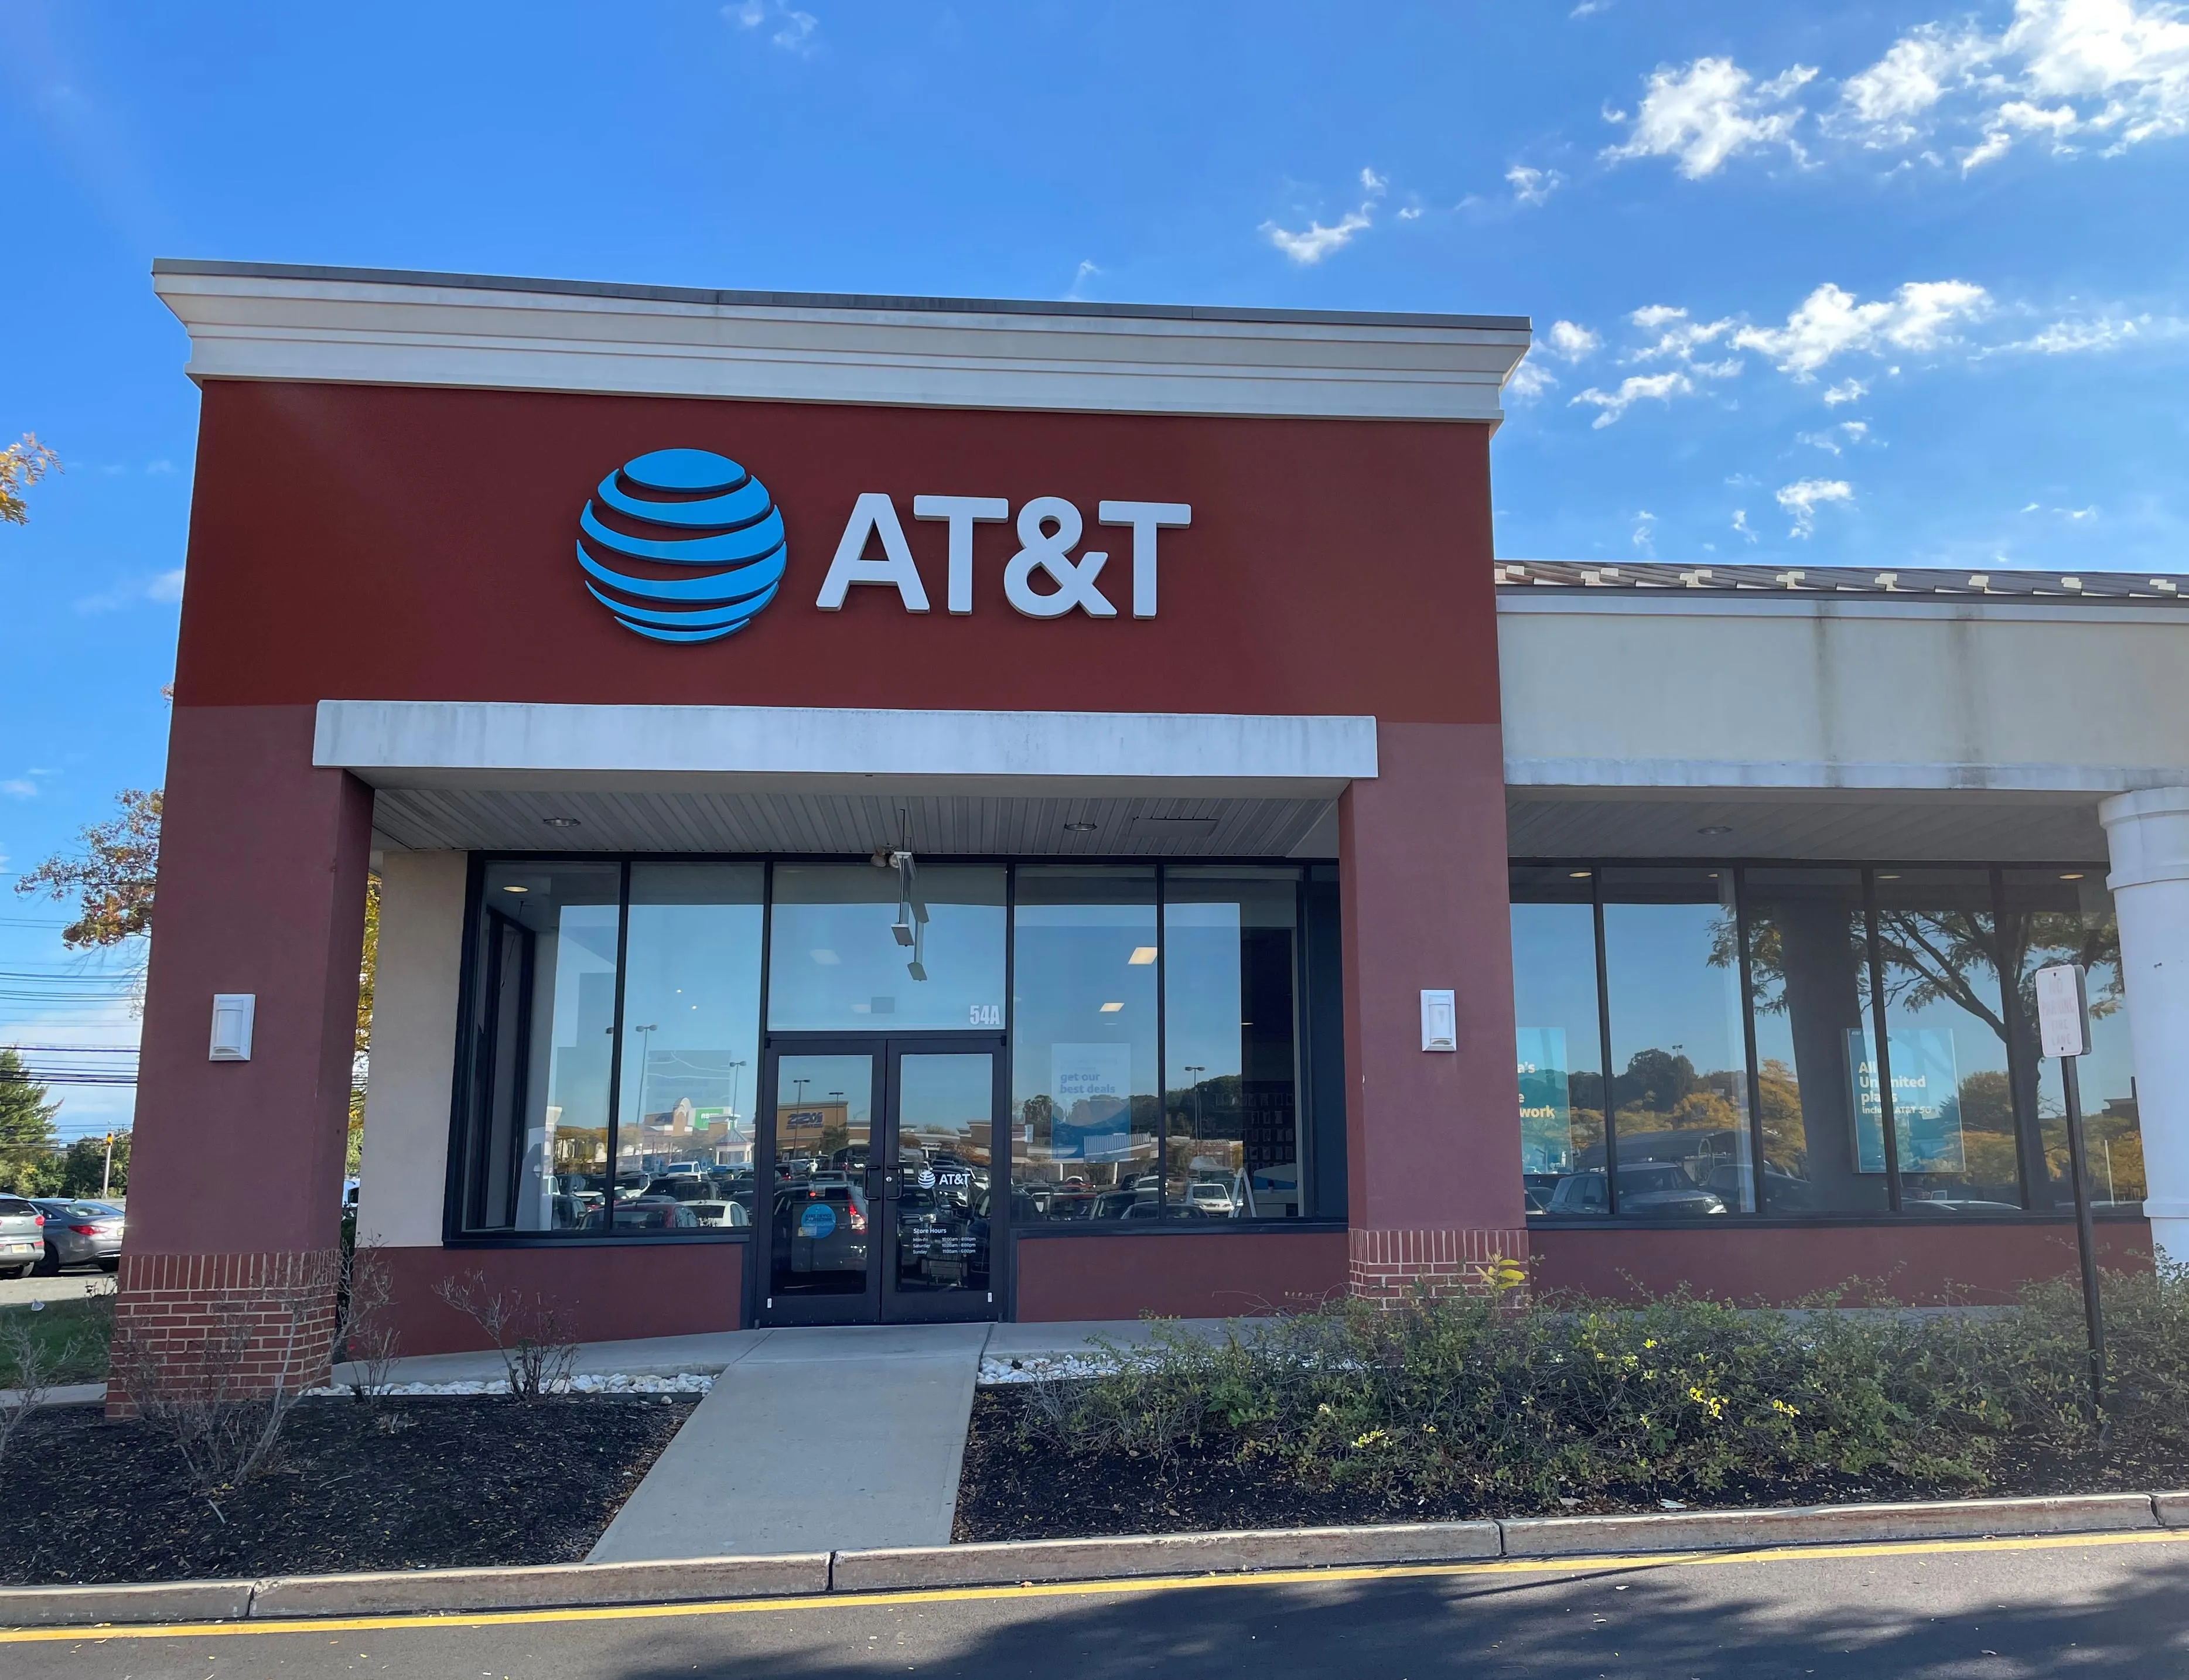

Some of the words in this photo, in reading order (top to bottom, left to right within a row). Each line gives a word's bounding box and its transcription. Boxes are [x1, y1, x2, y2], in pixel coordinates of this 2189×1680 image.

[816, 493, 1191, 620] AT&T
[2049, 978, 2063, 994] NO
[970, 1005, 1000, 1025] 54A
[1517, 1061, 1535, 1074] a's
[1859, 1061, 1877, 1074] All
[1060, 1073, 1079, 1084] get
[1859, 1075, 1926, 1088] Unmited
[1060, 1084, 1085, 1094] best
[1087, 1084, 1115, 1094] deals
[1861, 1090, 1898, 1106] plas
[1519, 1105, 1555, 1118] work
[939, 1173, 971, 1185] AT&T
